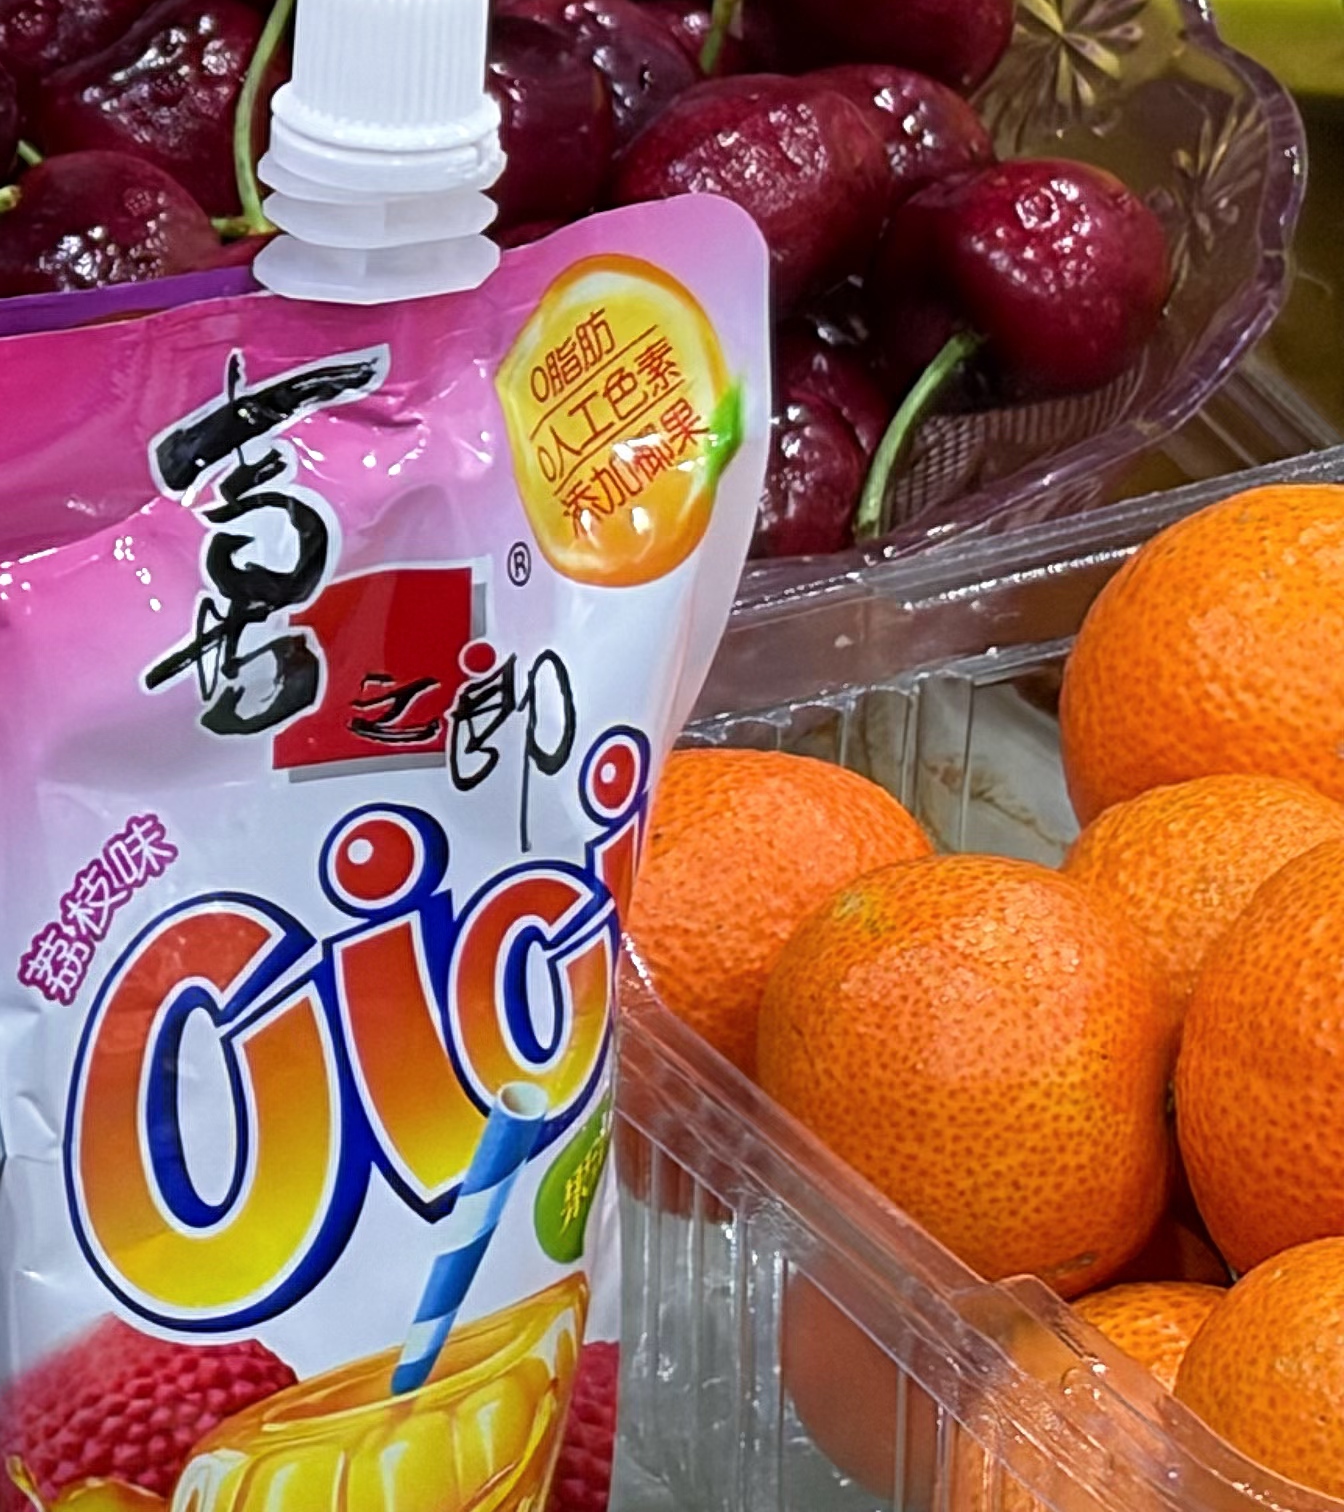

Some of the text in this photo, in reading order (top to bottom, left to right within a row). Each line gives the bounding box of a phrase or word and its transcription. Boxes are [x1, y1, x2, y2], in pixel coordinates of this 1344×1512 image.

[530, 308, 616, 403] 0脂肪
[536, 336, 682, 484] 0人工色素
[17, 813, 179, 1007] 荔枝味
